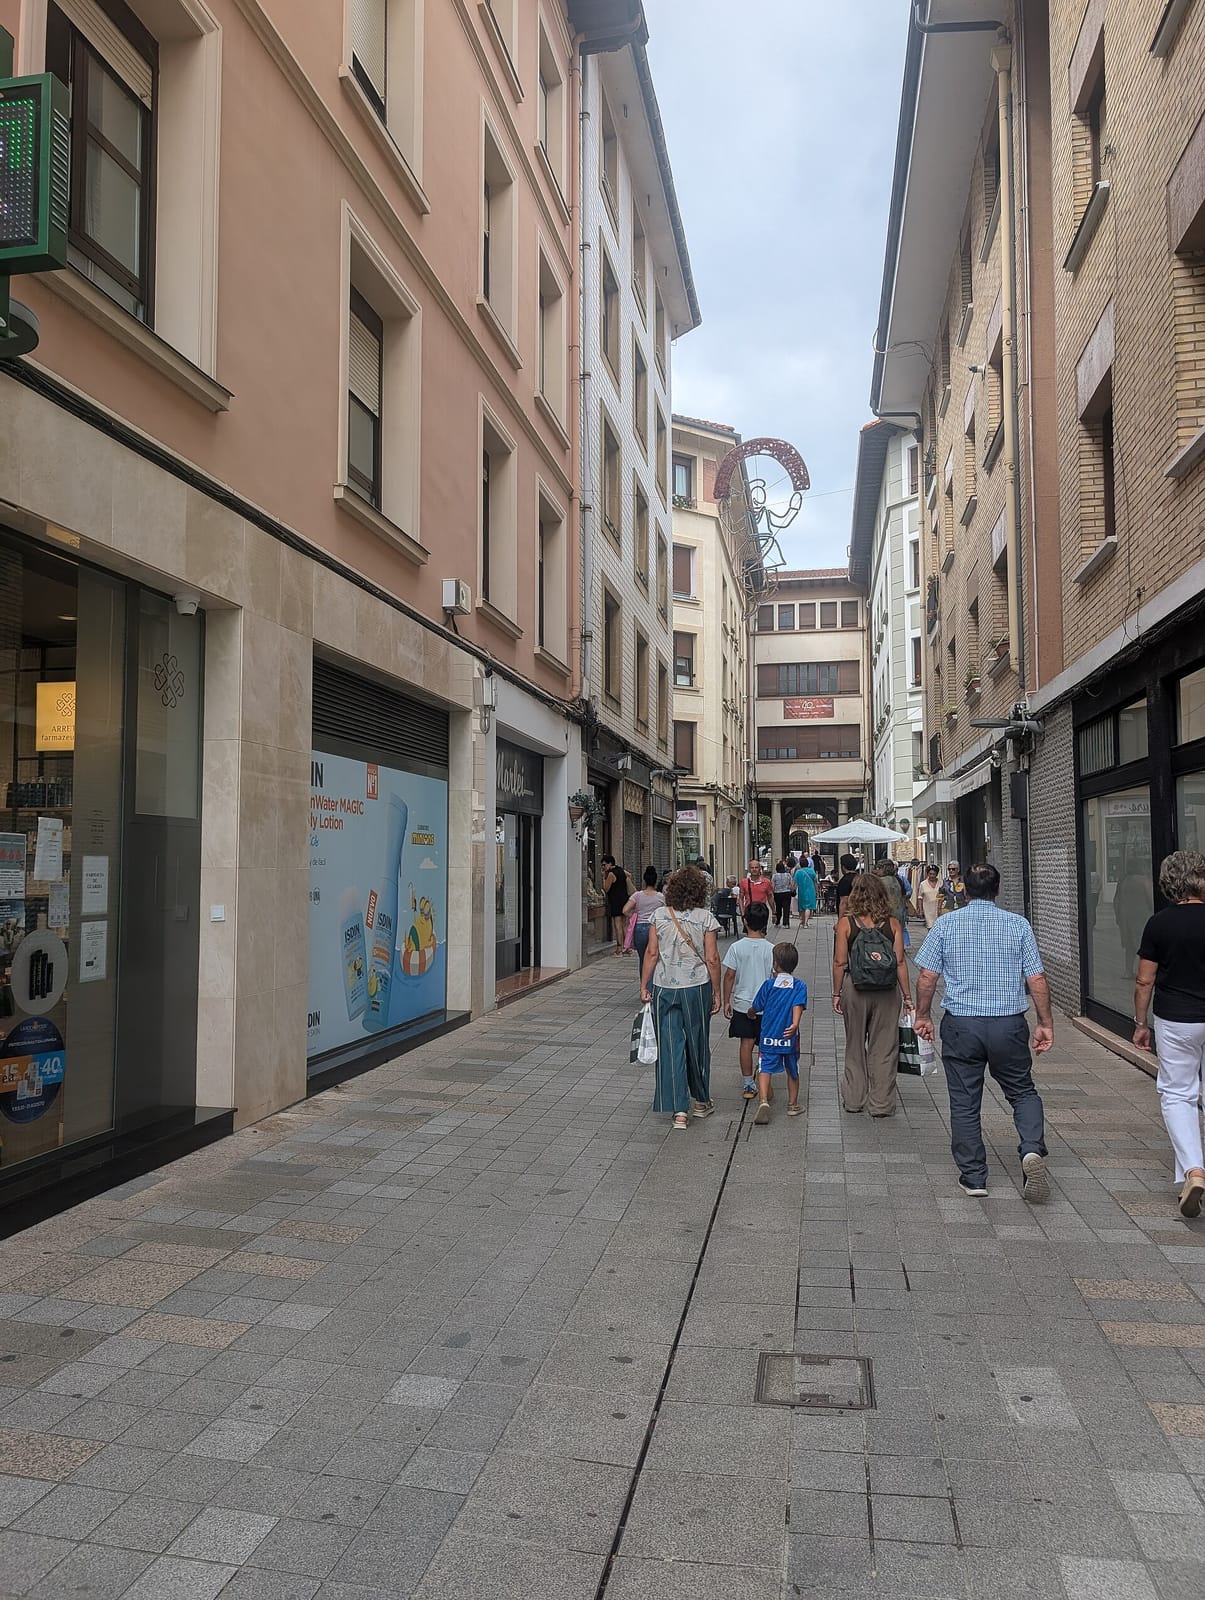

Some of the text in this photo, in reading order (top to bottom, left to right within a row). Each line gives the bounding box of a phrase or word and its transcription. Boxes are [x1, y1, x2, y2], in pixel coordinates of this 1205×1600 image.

[340, 798, 365, 815] MAGIC
[319, 813, 344, 831] Lotion
[367, 895, 376, 925] NUEVO
[377, 912, 393, 931] ISDIN
[344, 923, 361, 943] ISDIN
